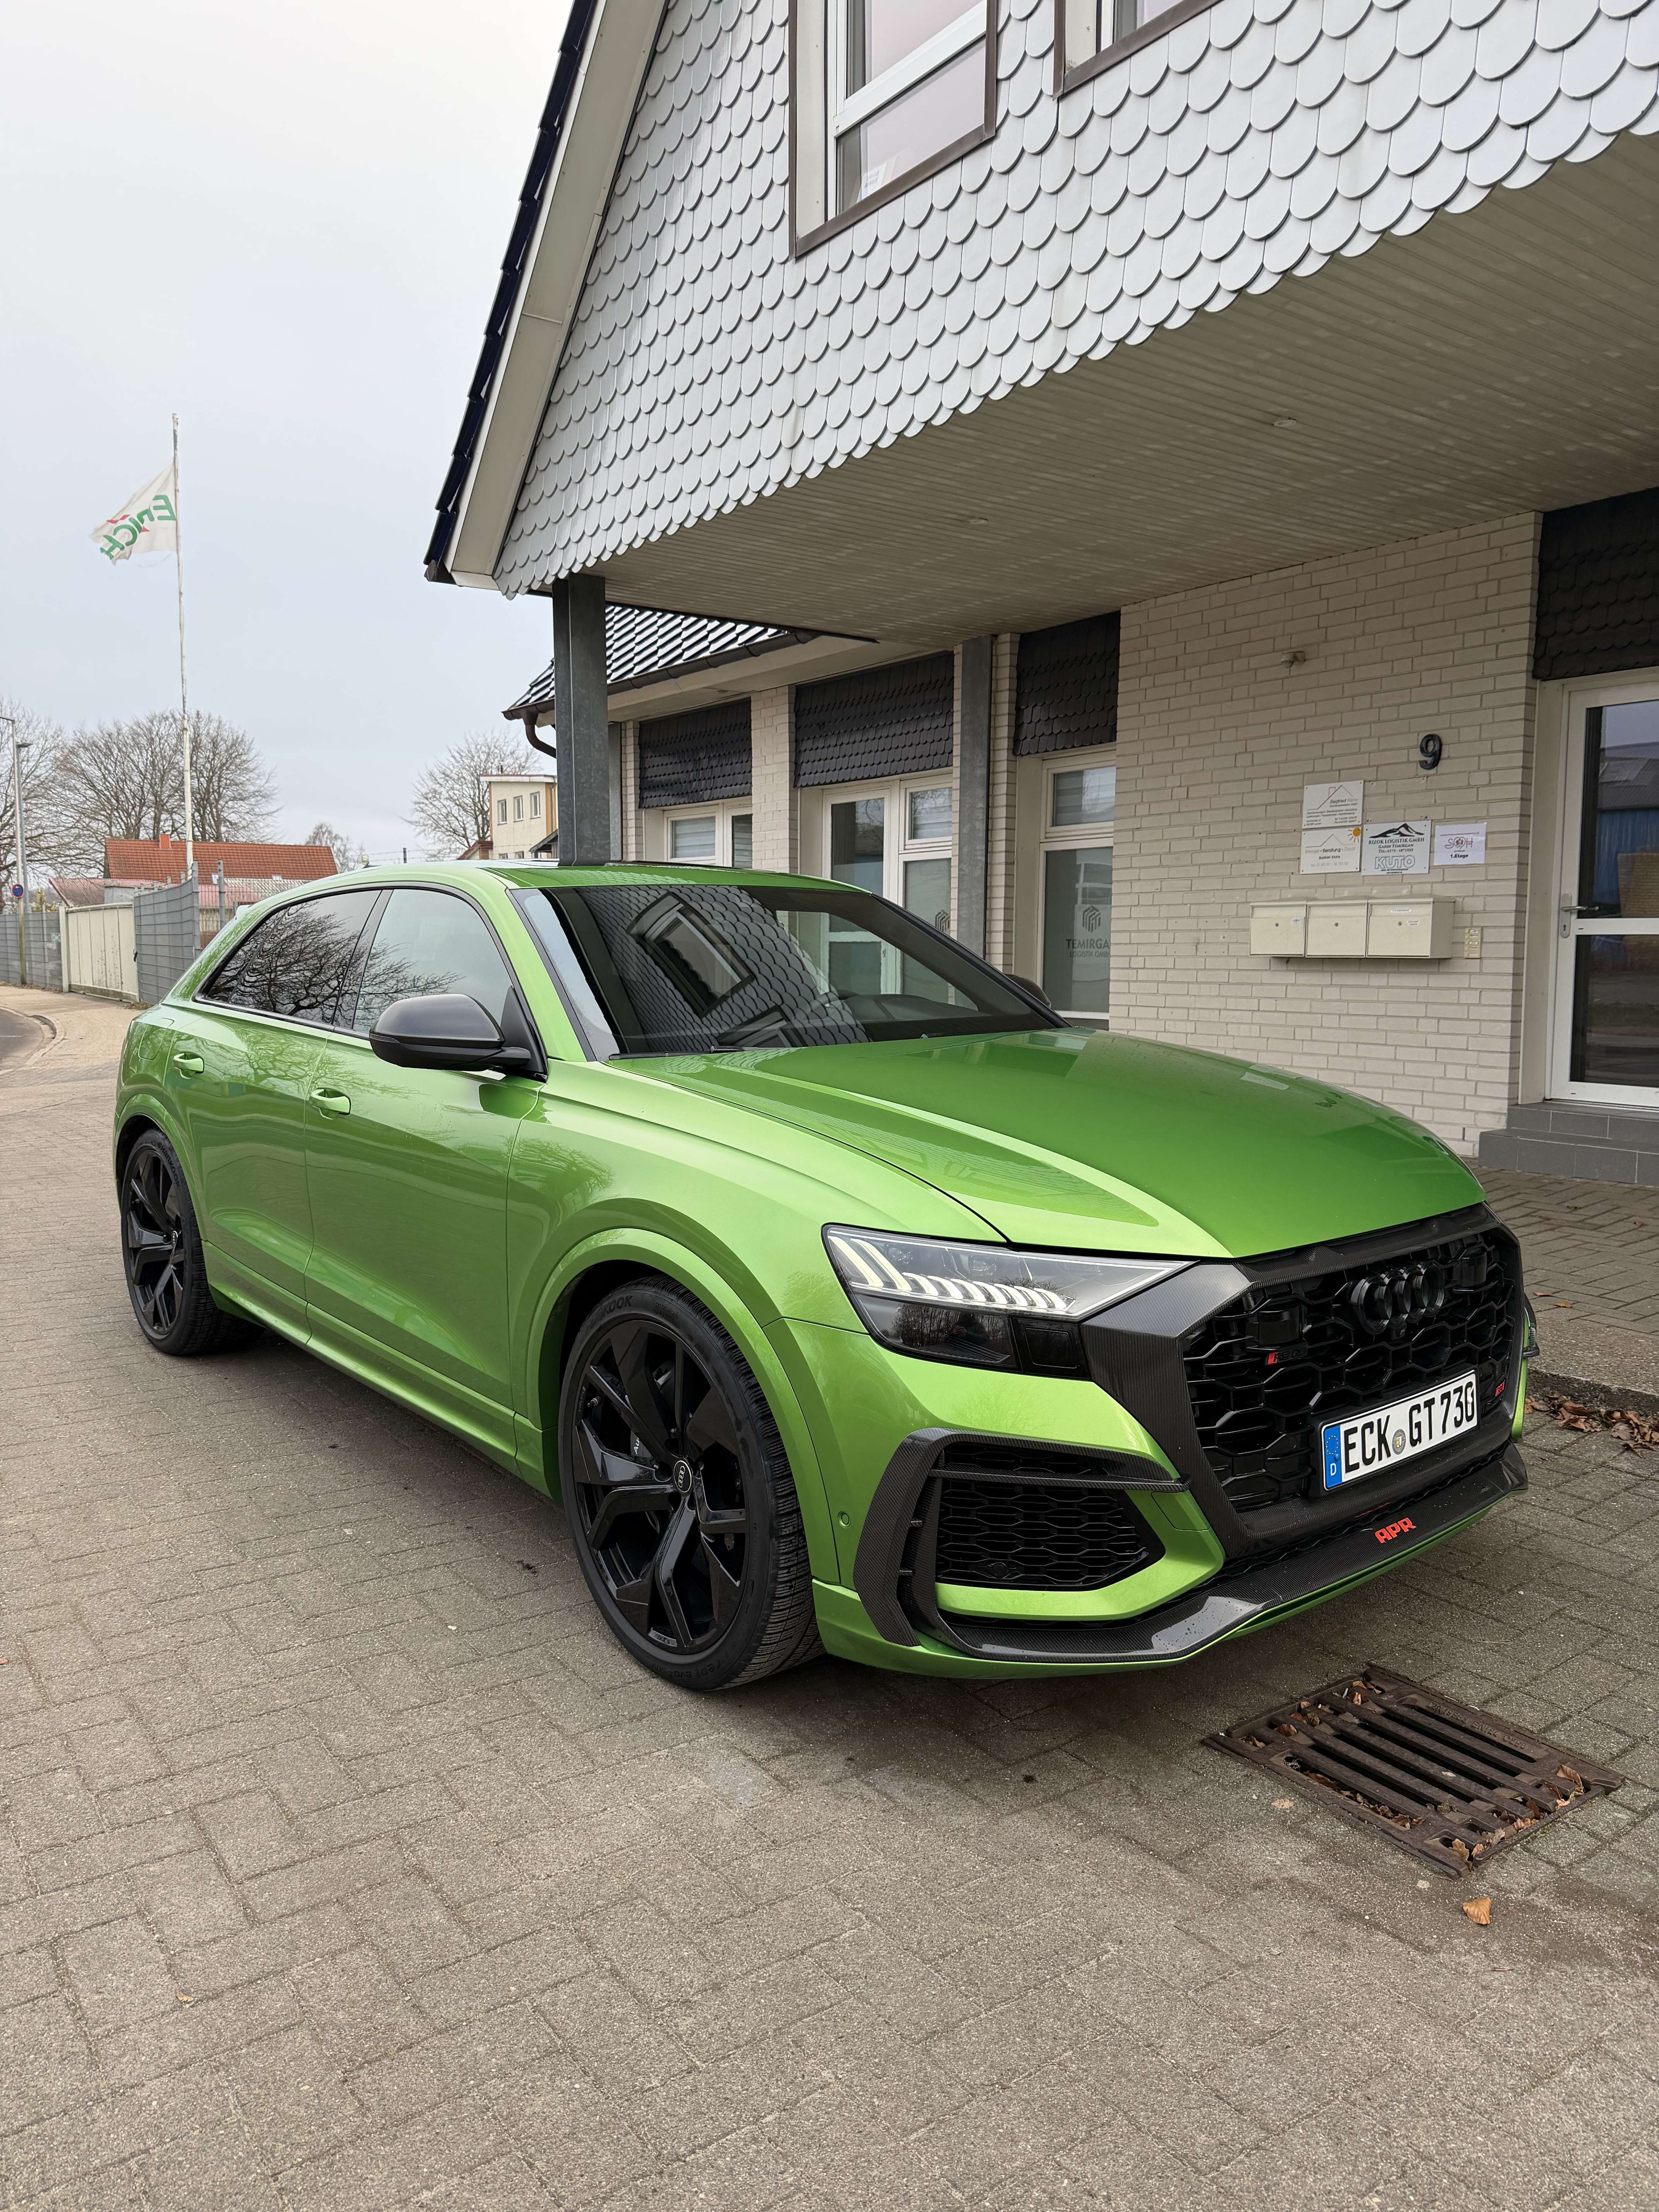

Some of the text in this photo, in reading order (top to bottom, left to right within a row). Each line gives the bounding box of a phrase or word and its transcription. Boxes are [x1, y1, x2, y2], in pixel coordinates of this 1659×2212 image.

[1419, 733, 1443, 770] 9
[1375, 855, 1415, 869] KUTO
[1065, 938, 1110, 949] TEMIRGA
[1330, 1381, 1475, 1476] D ECK GT 730
[1375, 1517, 1417, 1544] APR
